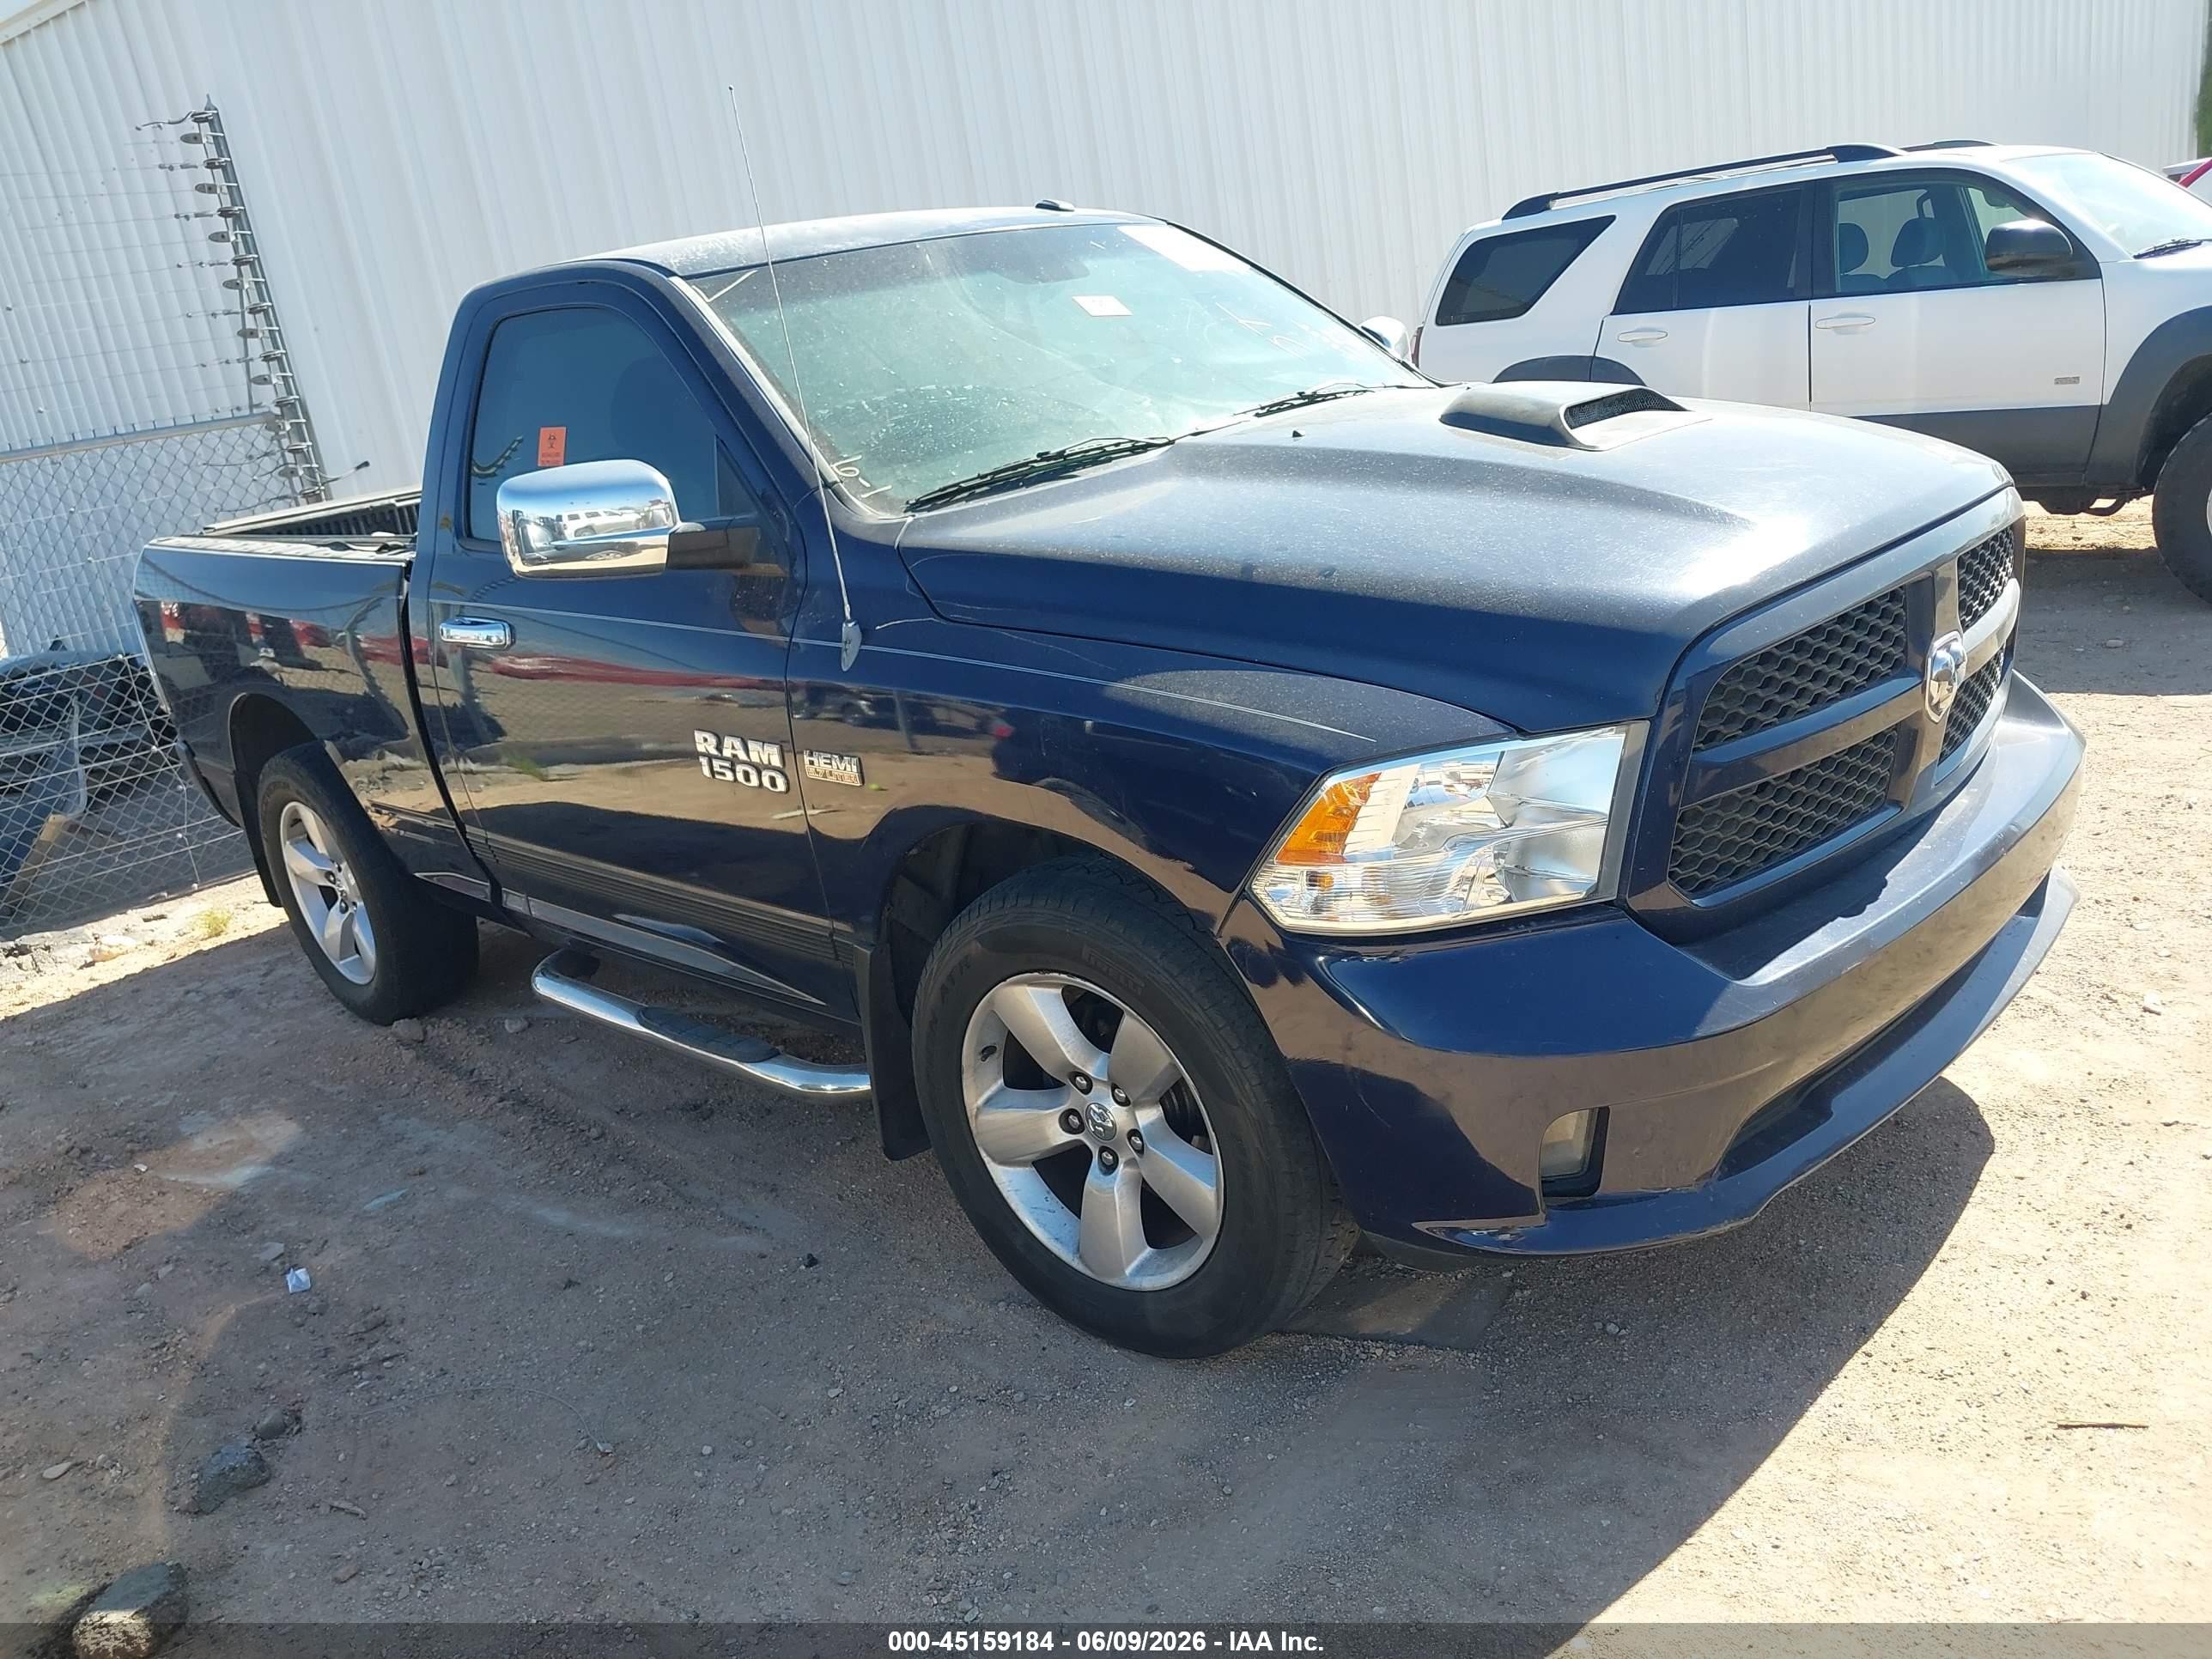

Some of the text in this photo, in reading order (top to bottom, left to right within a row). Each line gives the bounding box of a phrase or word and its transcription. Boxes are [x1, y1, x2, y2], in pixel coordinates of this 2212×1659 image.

[694, 729, 785, 769] RAM
[804, 750, 860, 773] HEMI
[699, 756, 789, 793] 1500
